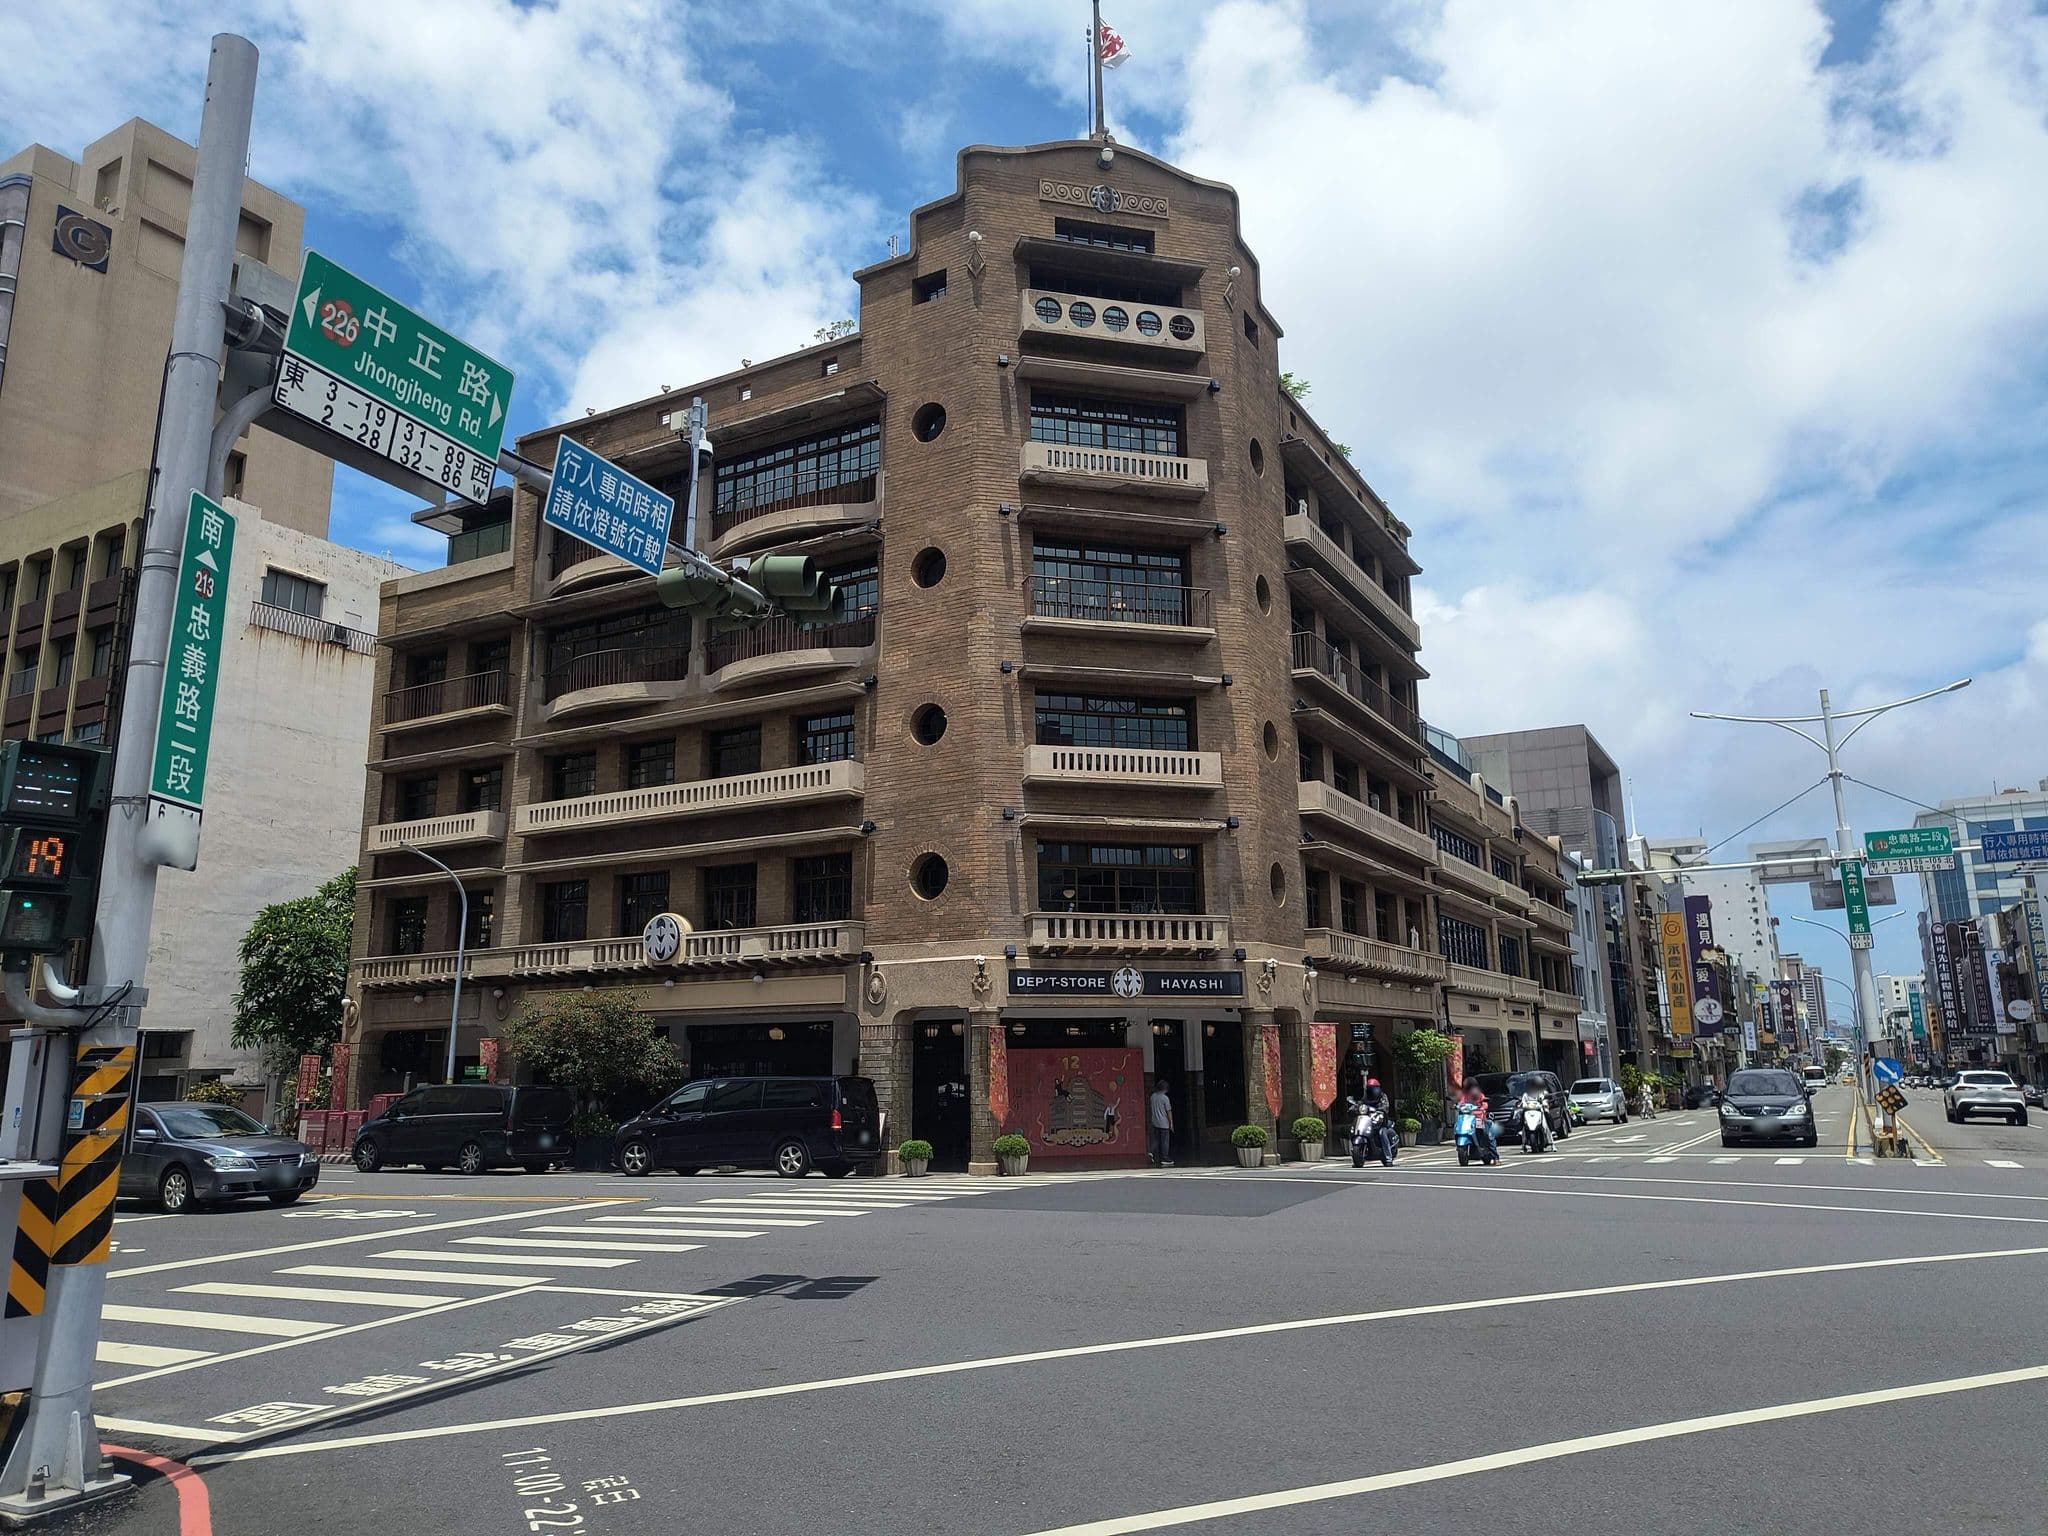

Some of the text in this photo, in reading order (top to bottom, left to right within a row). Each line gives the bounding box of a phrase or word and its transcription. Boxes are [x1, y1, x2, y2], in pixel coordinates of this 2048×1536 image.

[320, 303, 492, 408] 226 中正路
[281, 359, 310, 393] 東
[354, 351, 483, 440] Jhongjheng Rd.
[276, 386, 292, 407] E.
[471, 458, 491, 488] 西
[561, 449, 668, 534] 行人專用時相
[200, 506, 225, 549] 南
[551, 485, 662, 567] 請依燈號行駛
[194, 571, 215, 598] 213
[166, 603, 211, 794] 忠義路二段
[27, 837, 65, 876] 19
[1888, 831, 1942, 845] 忠義路二段
[1160, 977, 1225, 990] HAYASHI
